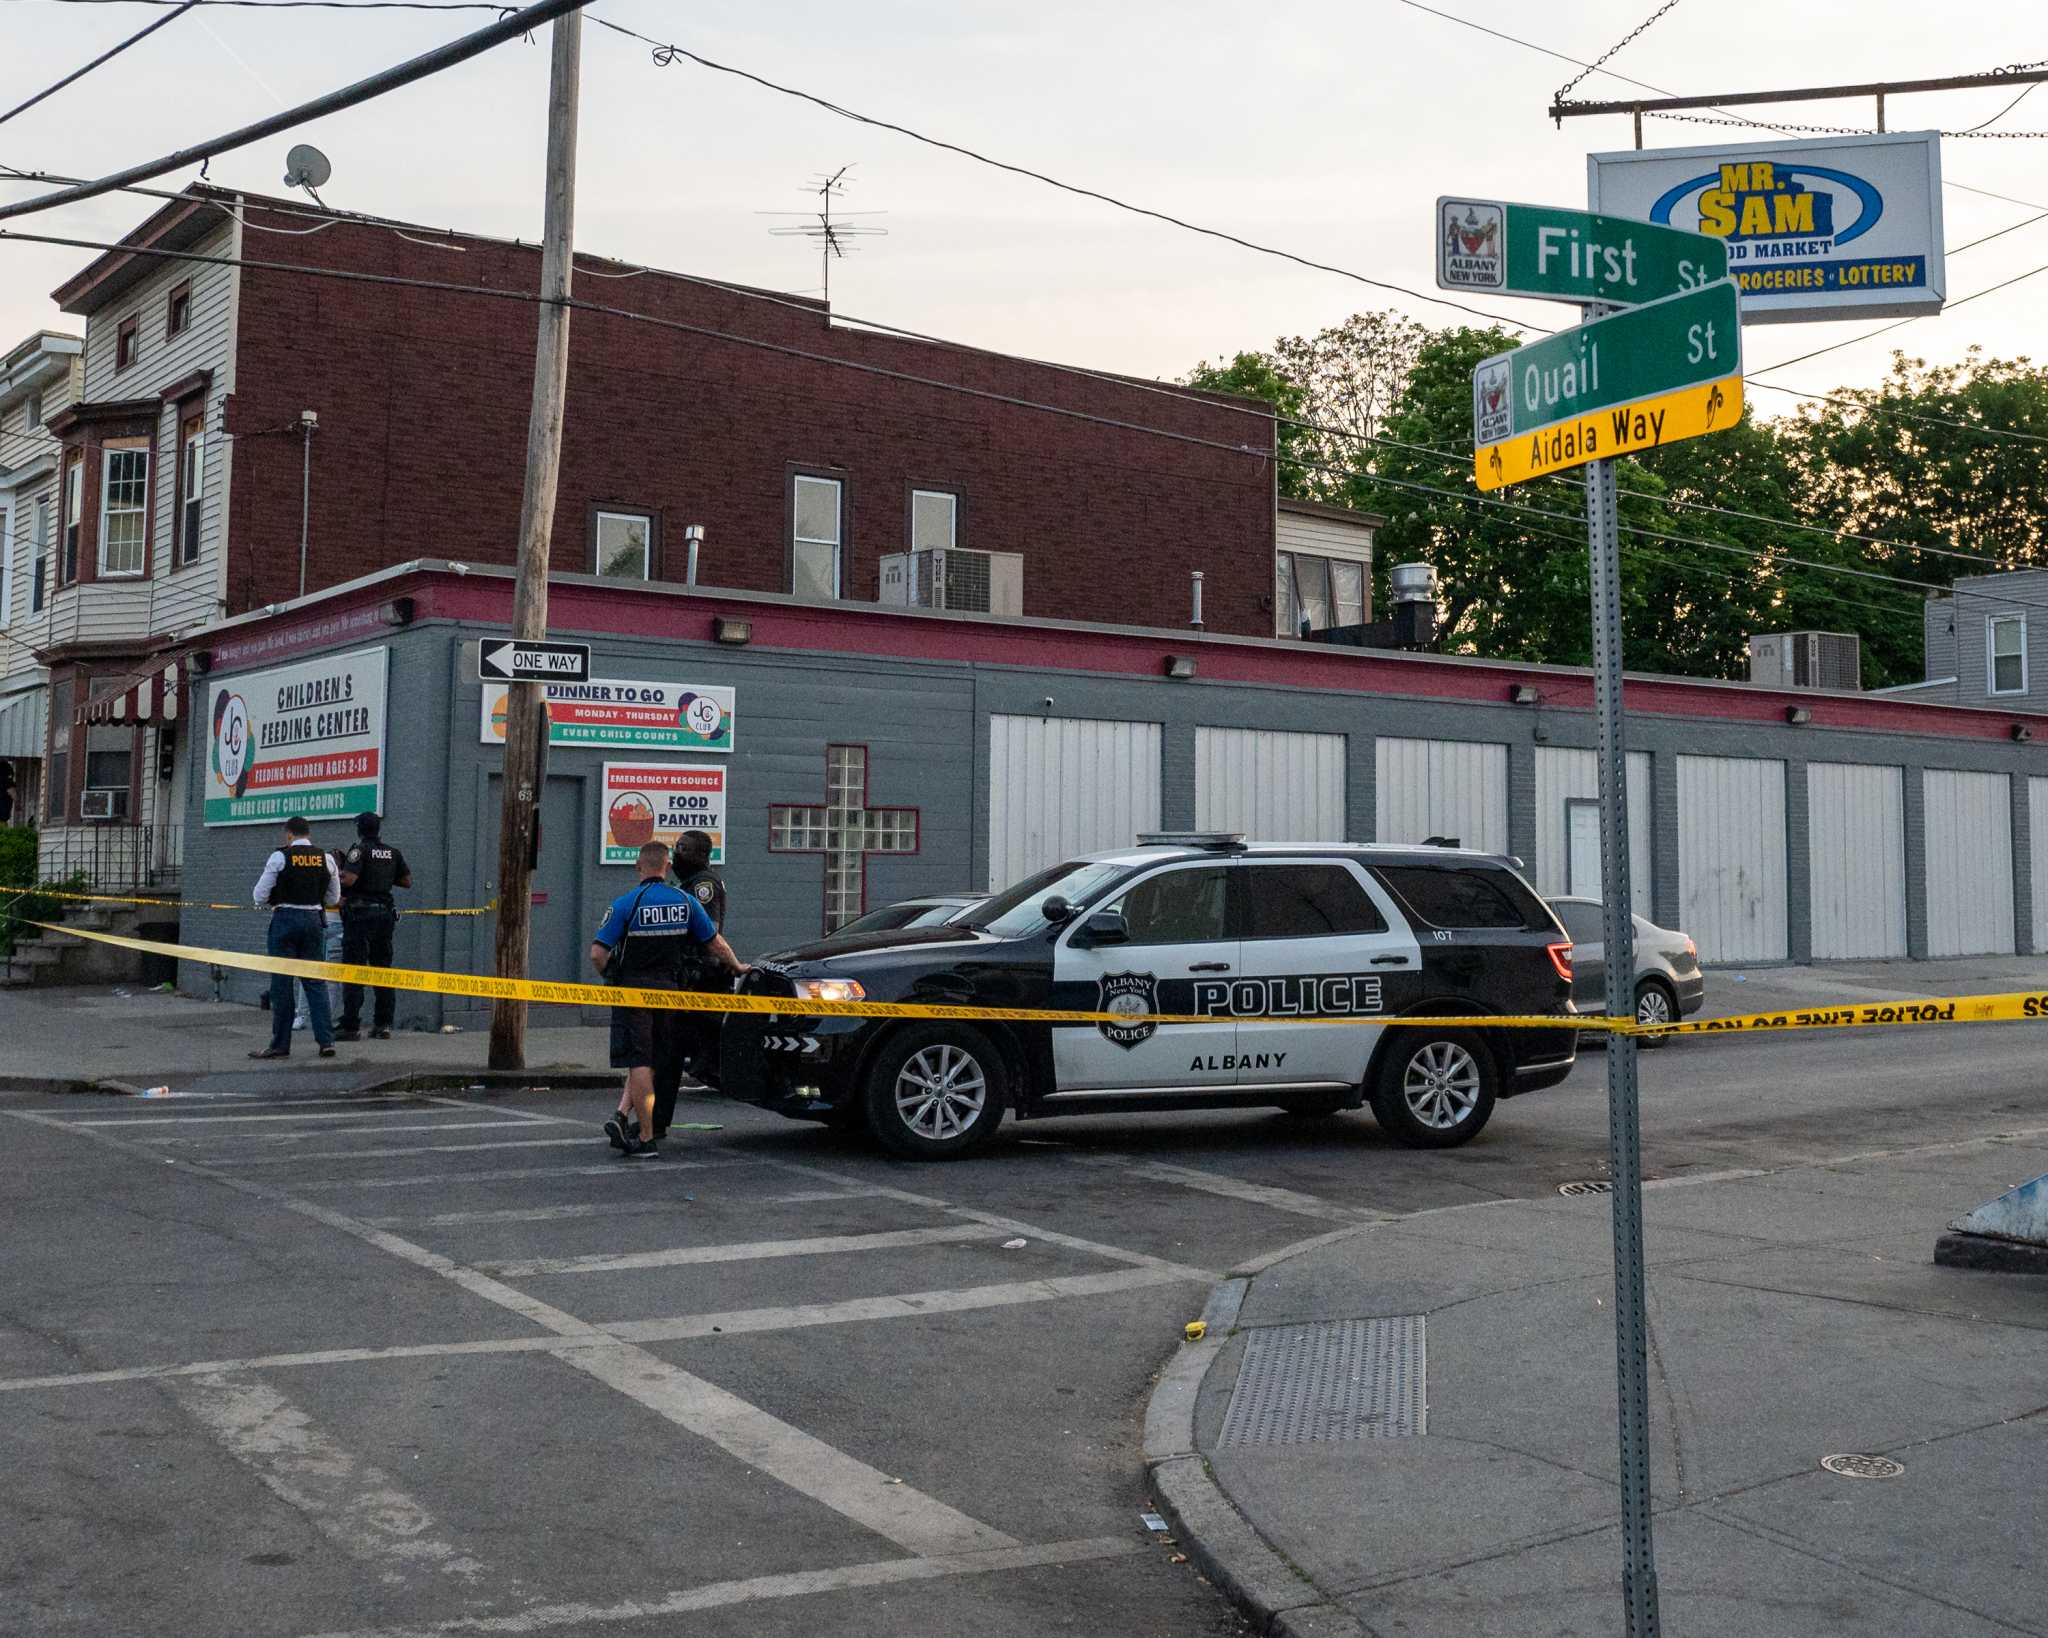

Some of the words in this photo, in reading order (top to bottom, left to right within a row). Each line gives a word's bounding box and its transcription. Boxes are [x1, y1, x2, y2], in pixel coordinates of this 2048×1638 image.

[1719, 162, 1785, 192] MR.
[1698, 190, 1815, 238] SAM
[1755, 240, 1832, 258] MARKET
[1450, 258, 1497, 271] ALBANY
[1538, 226, 1638, 287] First
[1678, 260, 1707, 293] St
[1450, 270, 1470, 281] NEW
[1472, 271, 1497, 283] YORK
[1839, 263, 1917, 285] LOTTERY
[1524, 333, 1599, 412] Quail
[1688, 320, 1717, 364] St
[1530, 422, 1597, 470] Aidala
[1612, 408, 1666, 447] Way
[513, 653, 543, 669] ONE
[548, 654, 578, 671] WAY
[277, 673, 353, 710] CHILDREN'S
[547, 684, 610, 700] DINNER
[615, 687, 637, 702] TO
[640, 689, 665, 703] GO
[575, 708, 618, 719] MONDAY
[626, 711, 676, 721] THURSDAY
[261, 716, 312, 745] FEEDING
[317, 706, 369, 738] CENTER
[562, 728, 597, 739] EVERY
[600, 729, 631, 739] CHILD
[635, 730, 679, 741] COUNTS
[695, 722, 711, 731] CLUB
[255, 765, 285, 784] FEEDING
[287, 762, 323, 780] CHILDREN
[326, 758, 347, 775] AGES
[349, 757, 368, 774] 2-18
[610, 774, 669, 784] EMERGENCY
[671, 776, 719, 785] RESOURCE
[283, 796, 308, 813] CHILD
[309, 793, 345, 811] COUNTS
[669, 796, 708, 808] FOOD
[658, 813, 718, 826] PANTRY
[291, 855, 323, 867] POLICE
[372, 849, 392, 860] POLICE
[610, 850, 623, 858] BY
[642, 905, 686, 925] POLICE
[1432, 930, 1453, 941] 107
[1105, 977, 1152, 991] ALBANY
[1110, 987, 1127, 997] New
[1129, 986, 1147, 997] York
[1193, 976, 1384, 1018] POLICE
[1796, 1011, 1855, 1027] LINE
[1862, 1003, 1956, 1023] POLICE
[1107, 1025, 1150, 1041] POLICE
[1189, 1052, 1288, 1071] ALBANY
